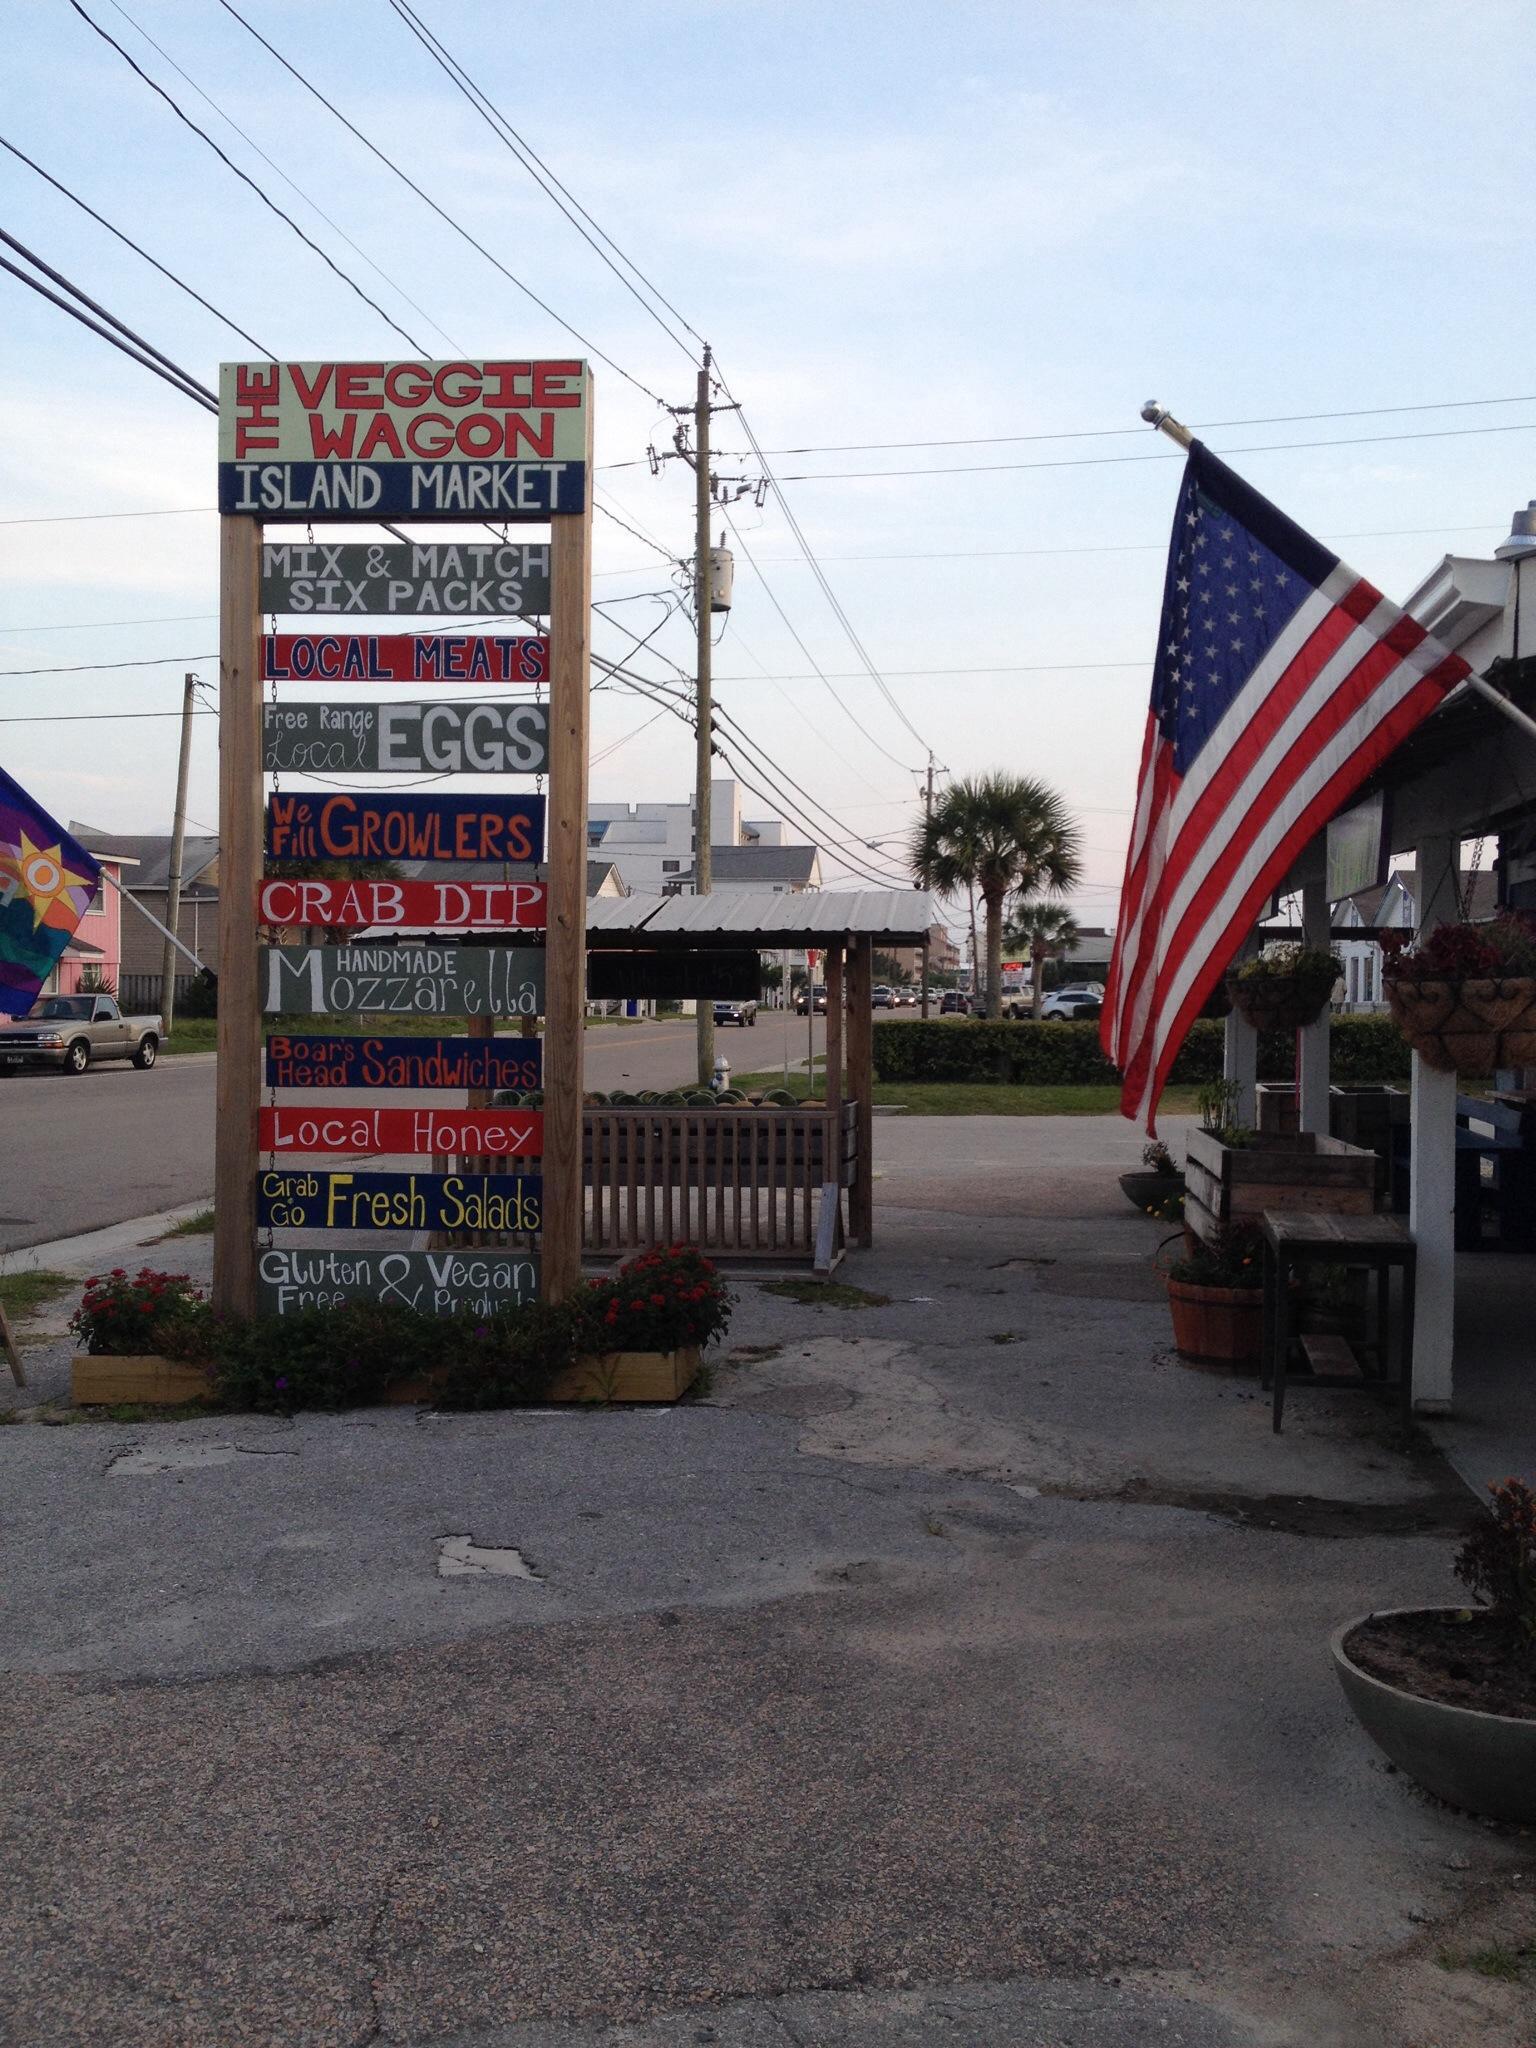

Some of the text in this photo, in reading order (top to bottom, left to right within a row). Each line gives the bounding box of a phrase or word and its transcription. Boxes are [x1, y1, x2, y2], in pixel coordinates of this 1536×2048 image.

[287, 361, 583, 410] VEGGIE
[236, 365, 280, 459] THE
[308, 413, 555, 460] WAGON
[235, 463, 567, 510] ISLAND MARKET
[263, 545, 549, 579] MIX & MATCH
[289, 579, 523, 612] SIX PACKS
[265, 636, 545, 680] LOCAL MEATS
[264, 705, 373, 739] Free Range
[378, 705, 547, 771] EGGS
[267, 731, 372, 769] Local
[272, 797, 312, 824] We
[320, 795, 533, 860] GROWLERS
[273, 826, 318, 858] Fill
[261, 881, 543, 925] CRAB DIP
[264, 949, 537, 1015] Mozzarella
[337, 950, 457, 975] HANDMADE
[271, 1037, 355, 1062] Boar's
[362, 1039, 537, 1088] Sandwiches
[278, 1061, 348, 1086] Head
[275, 1110, 533, 1152] Local Honey
[262, 1173, 318, 1199] Grab
[327, 1174, 541, 1231] Fresh Salads
[271, 1202, 305, 1227] Go
[259, 1250, 371, 1286] Gluten
[426, 1254, 536, 1290] Vegan
